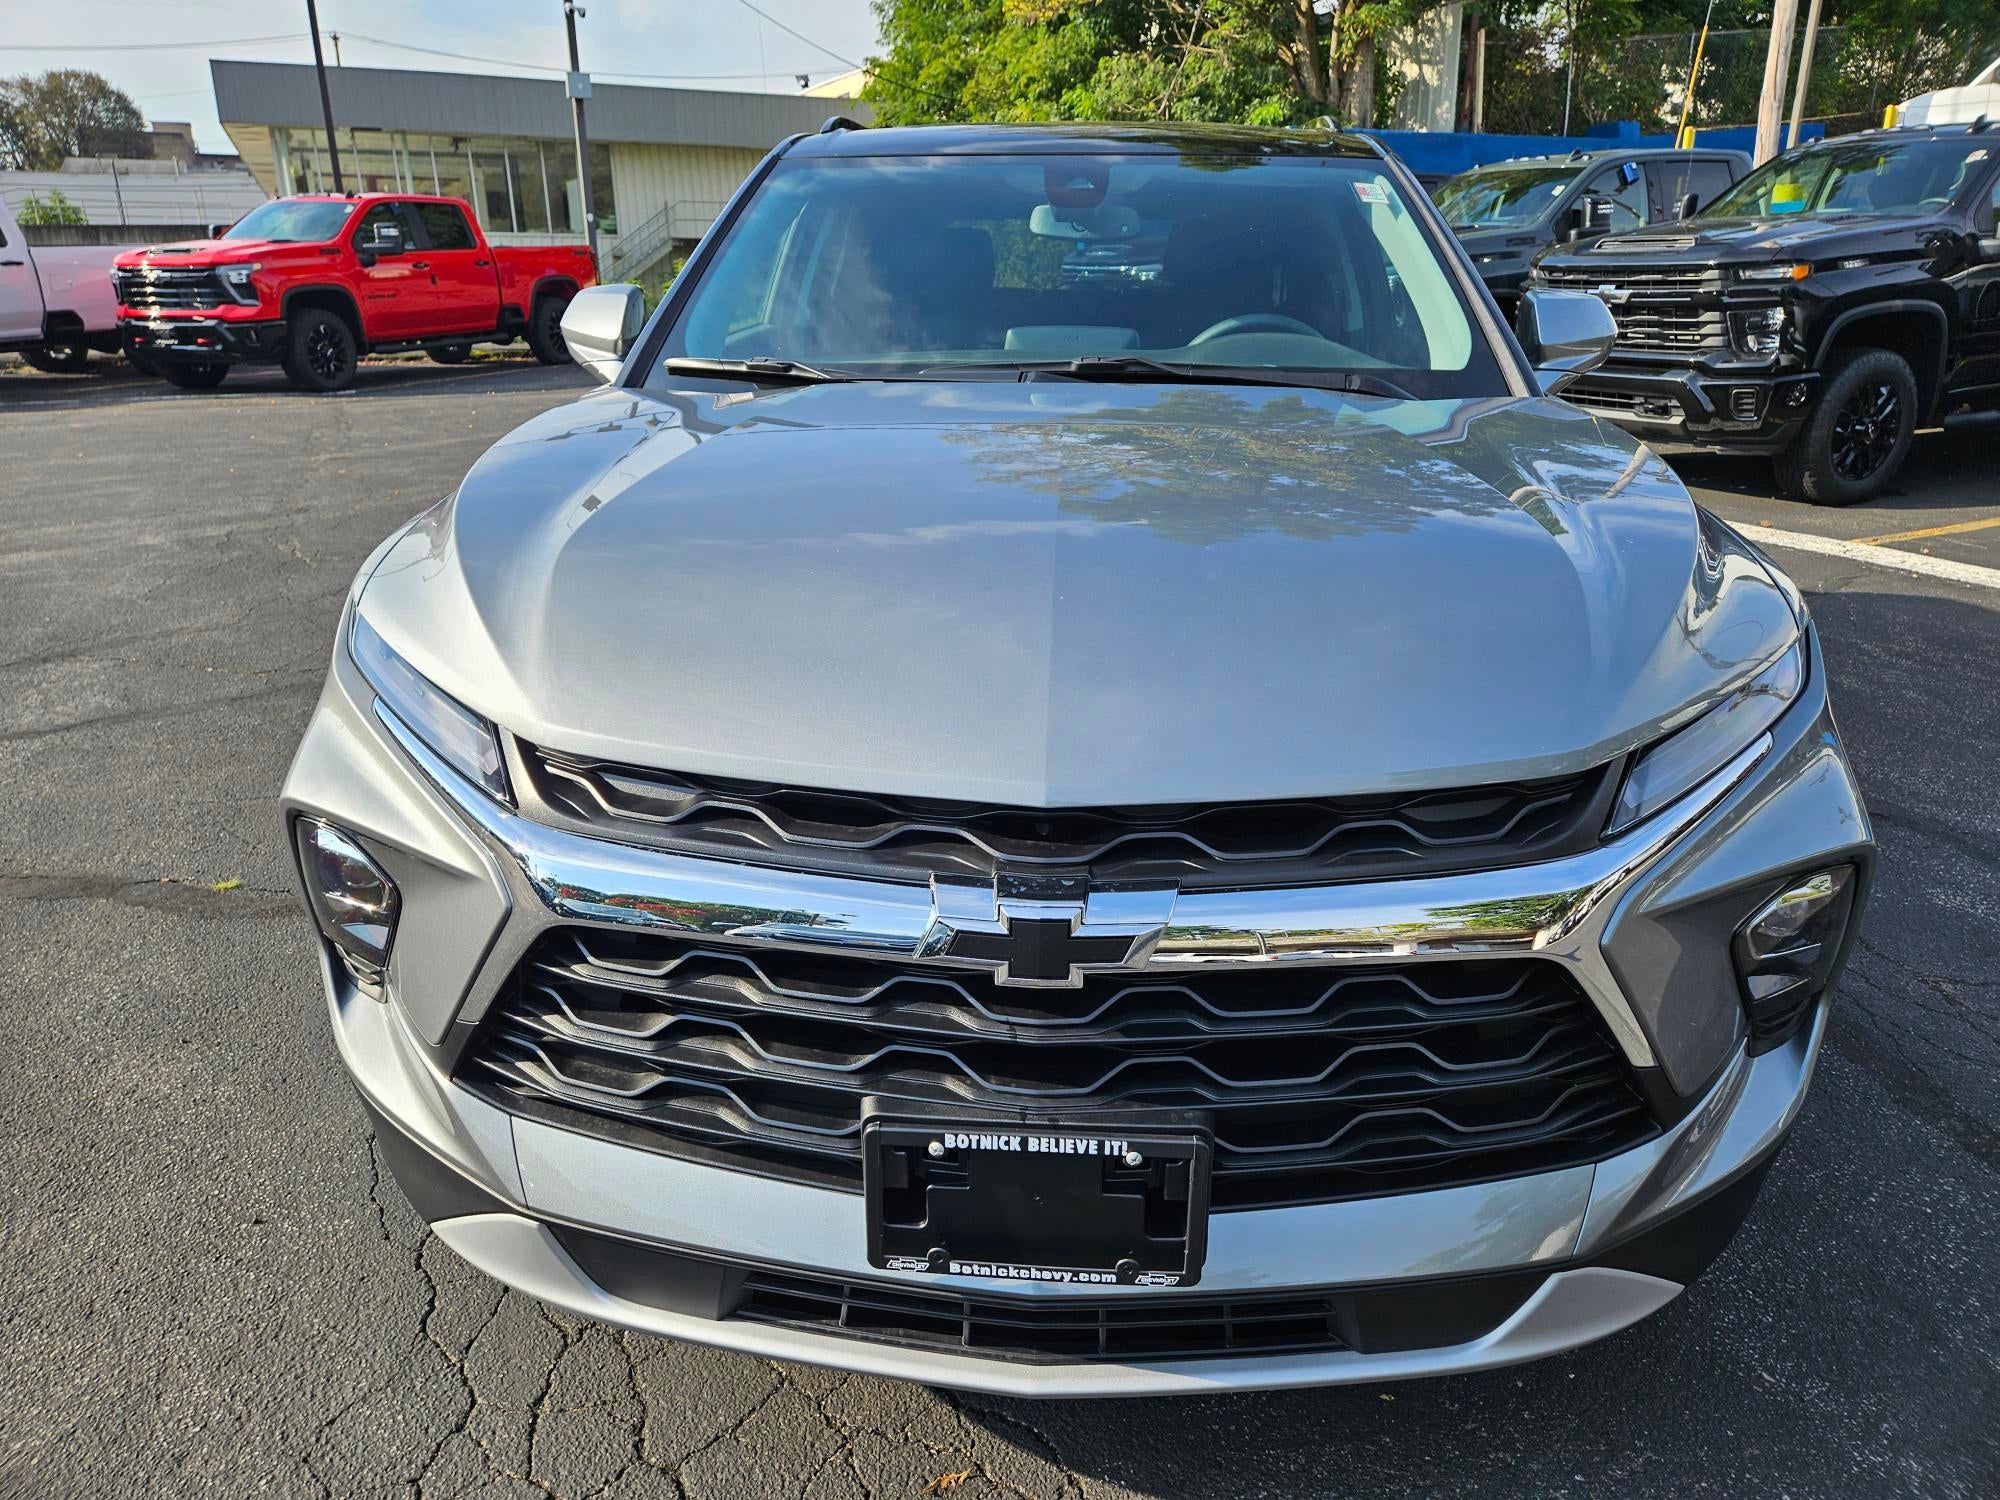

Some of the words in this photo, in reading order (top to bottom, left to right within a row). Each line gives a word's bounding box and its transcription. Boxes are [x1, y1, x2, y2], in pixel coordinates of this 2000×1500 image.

[944, 1132, 1022, 1152] BOTNICK
[1027, 1136, 1099, 1155] BELIEVE
[1104, 1140, 1129, 1157] IT!
[949, 1261, 1118, 1284] Botnickchevy.com
